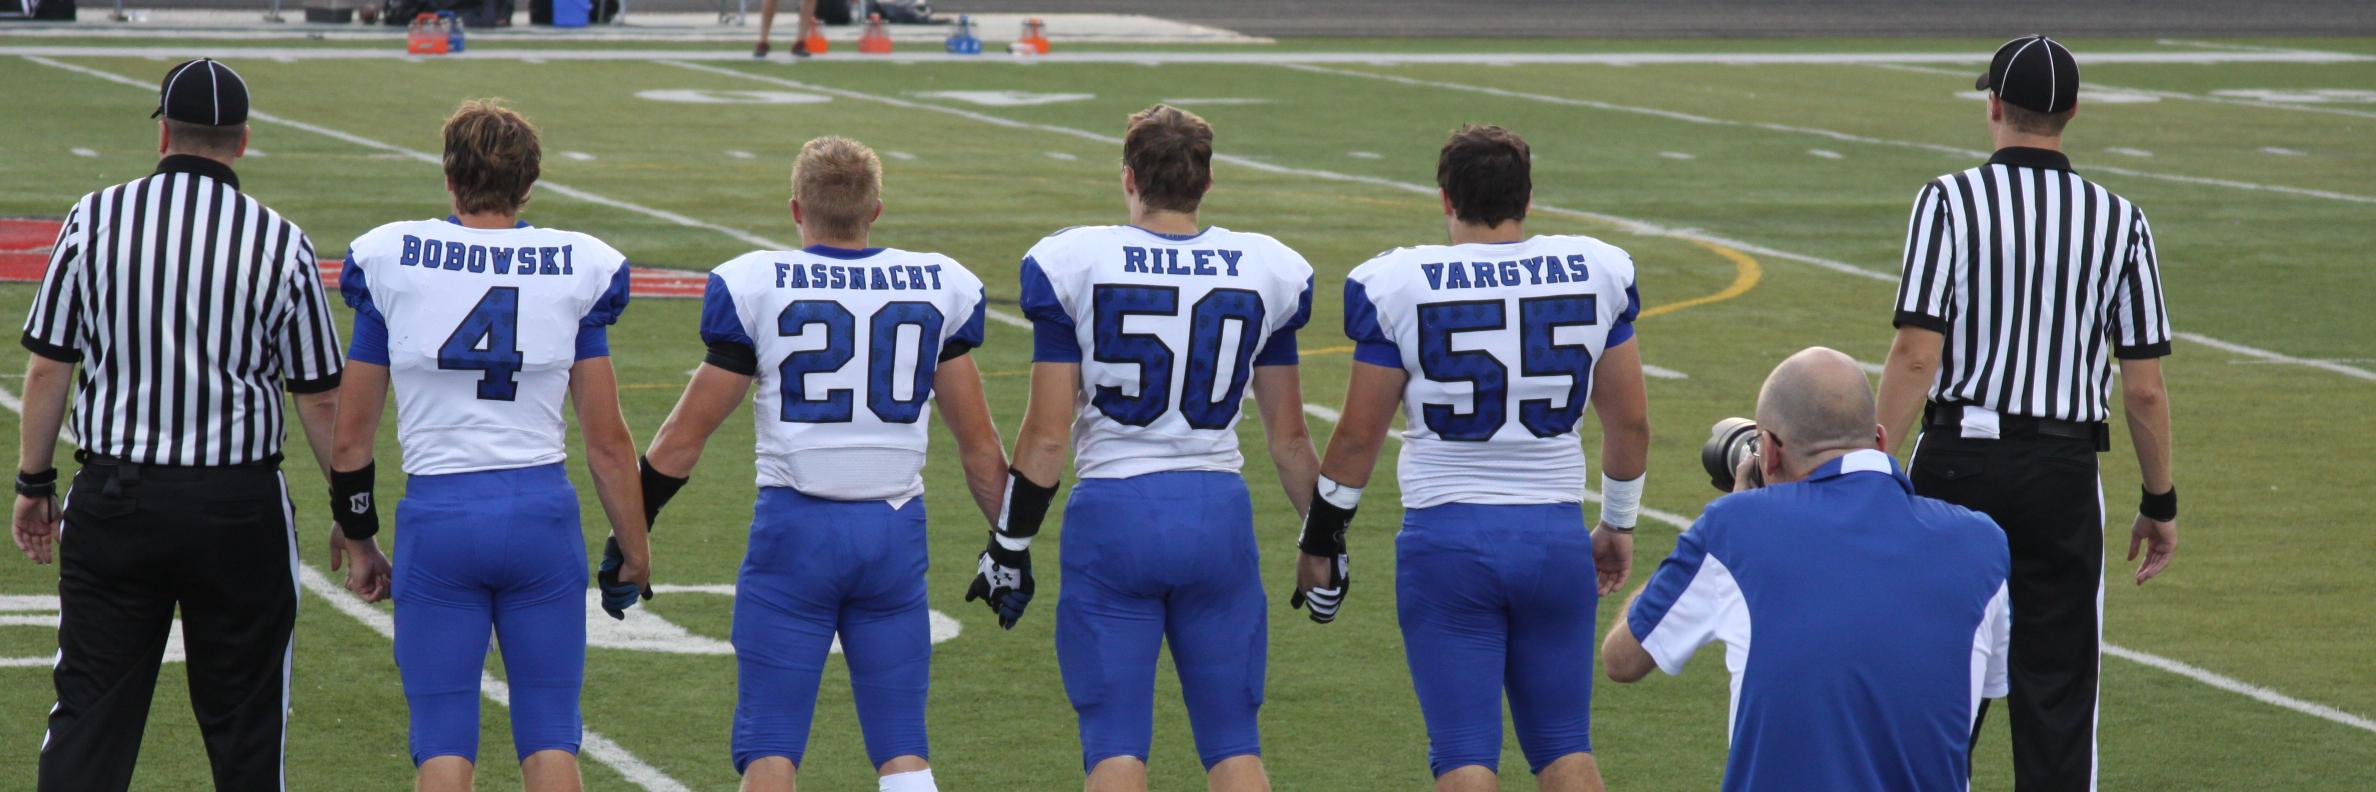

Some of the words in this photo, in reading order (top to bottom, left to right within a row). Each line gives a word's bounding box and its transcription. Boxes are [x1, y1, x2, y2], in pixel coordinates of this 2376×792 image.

[400, 234, 573, 276] BOBOWSKI
[774, 261, 943, 290] FASSNACHT
[1122, 245, 1243, 277] RILEY
[1421, 254, 1590, 290] VARGYAS
[437, 285, 524, 402] 4
[777, 299, 945, 425] 20
[1092, 283, 1266, 431] 50
[1416, 293, 1598, 442] 55
